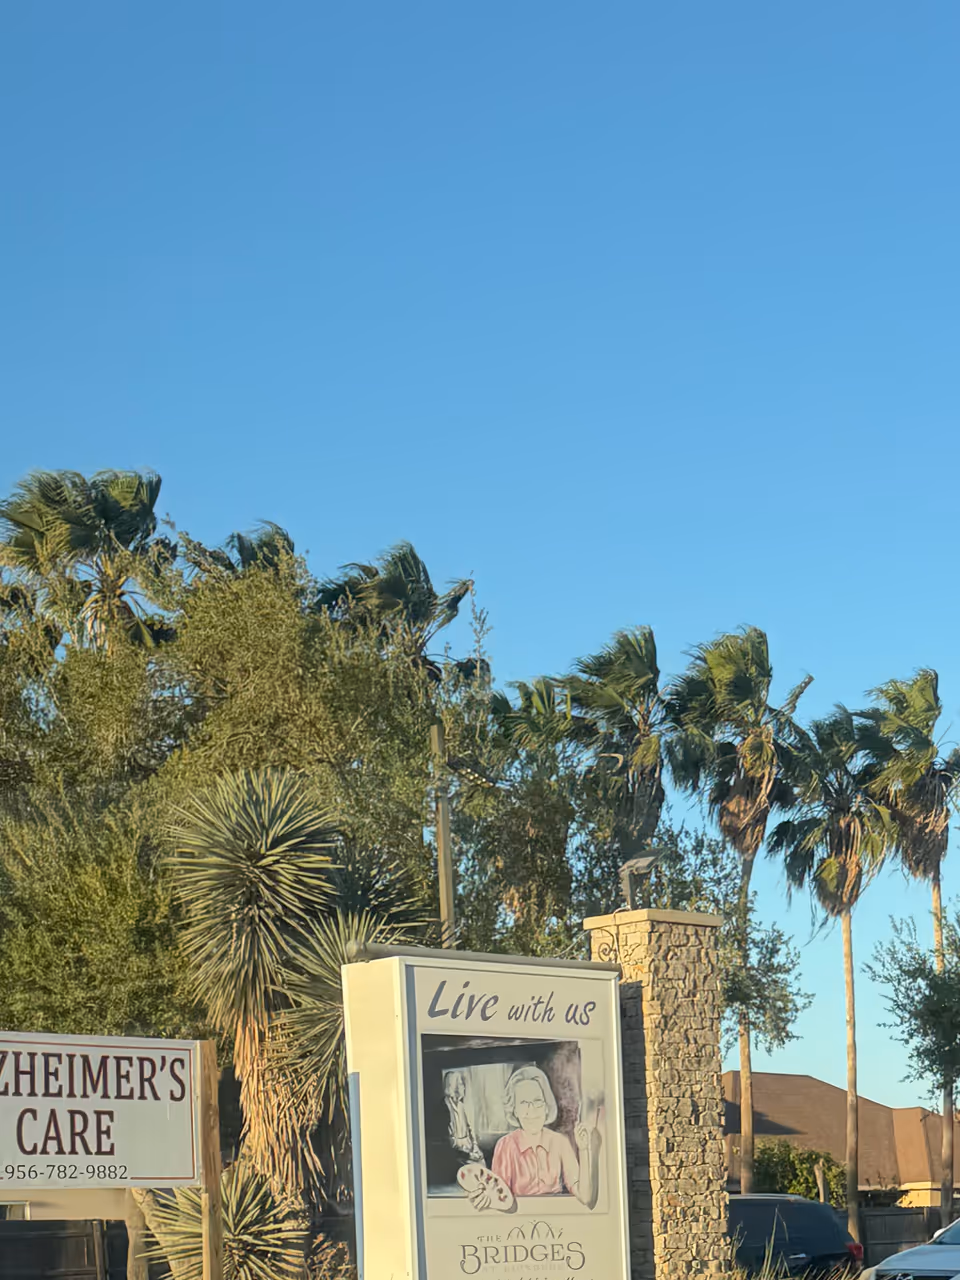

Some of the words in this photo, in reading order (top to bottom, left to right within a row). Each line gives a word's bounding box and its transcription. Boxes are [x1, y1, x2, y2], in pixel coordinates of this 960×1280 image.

[427, 980, 499, 1021] Live
[508, 991, 555, 1023] with
[565, 1001, 596, 1026] us
[16, 1108, 115, 1156] CARE
[4, 1164, 128, 1180] 956-782-9882
[476, 1234, 502, 1243] THE
[458, 1241, 586, 1275] BRIDGES
